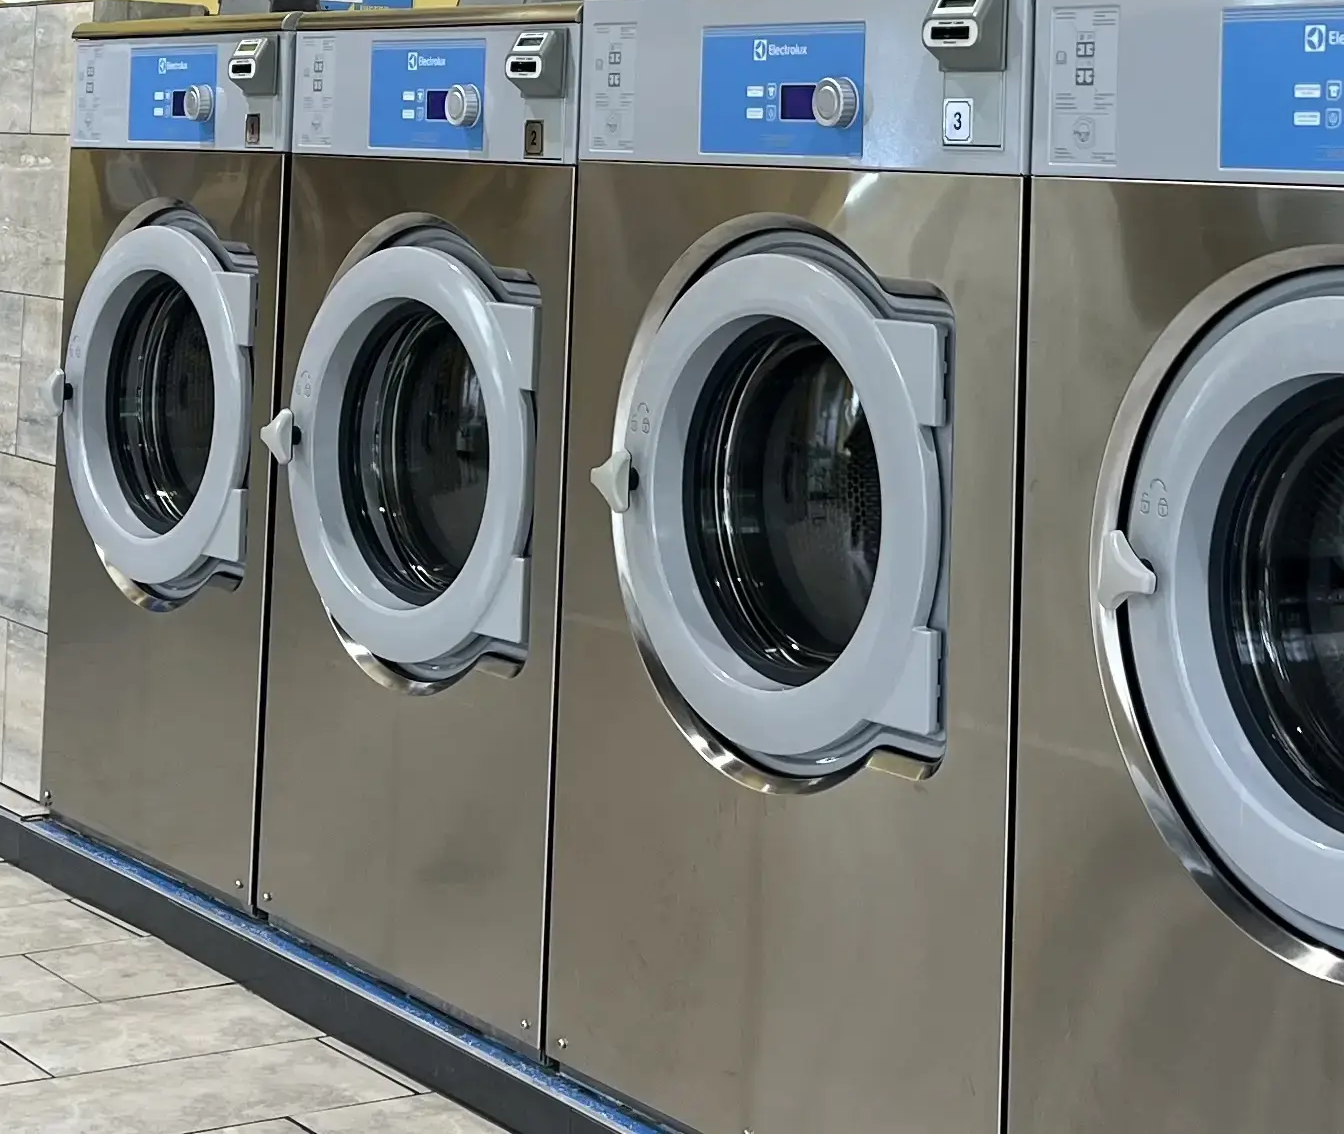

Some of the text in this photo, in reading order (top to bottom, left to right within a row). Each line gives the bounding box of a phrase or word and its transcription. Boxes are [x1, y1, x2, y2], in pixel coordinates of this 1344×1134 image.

[768, 43, 808, 56] Electrolux
[418, 55, 446, 68] Electrolux
[953, 112, 962, 131] 3
[530, 130, 537, 146] 2
